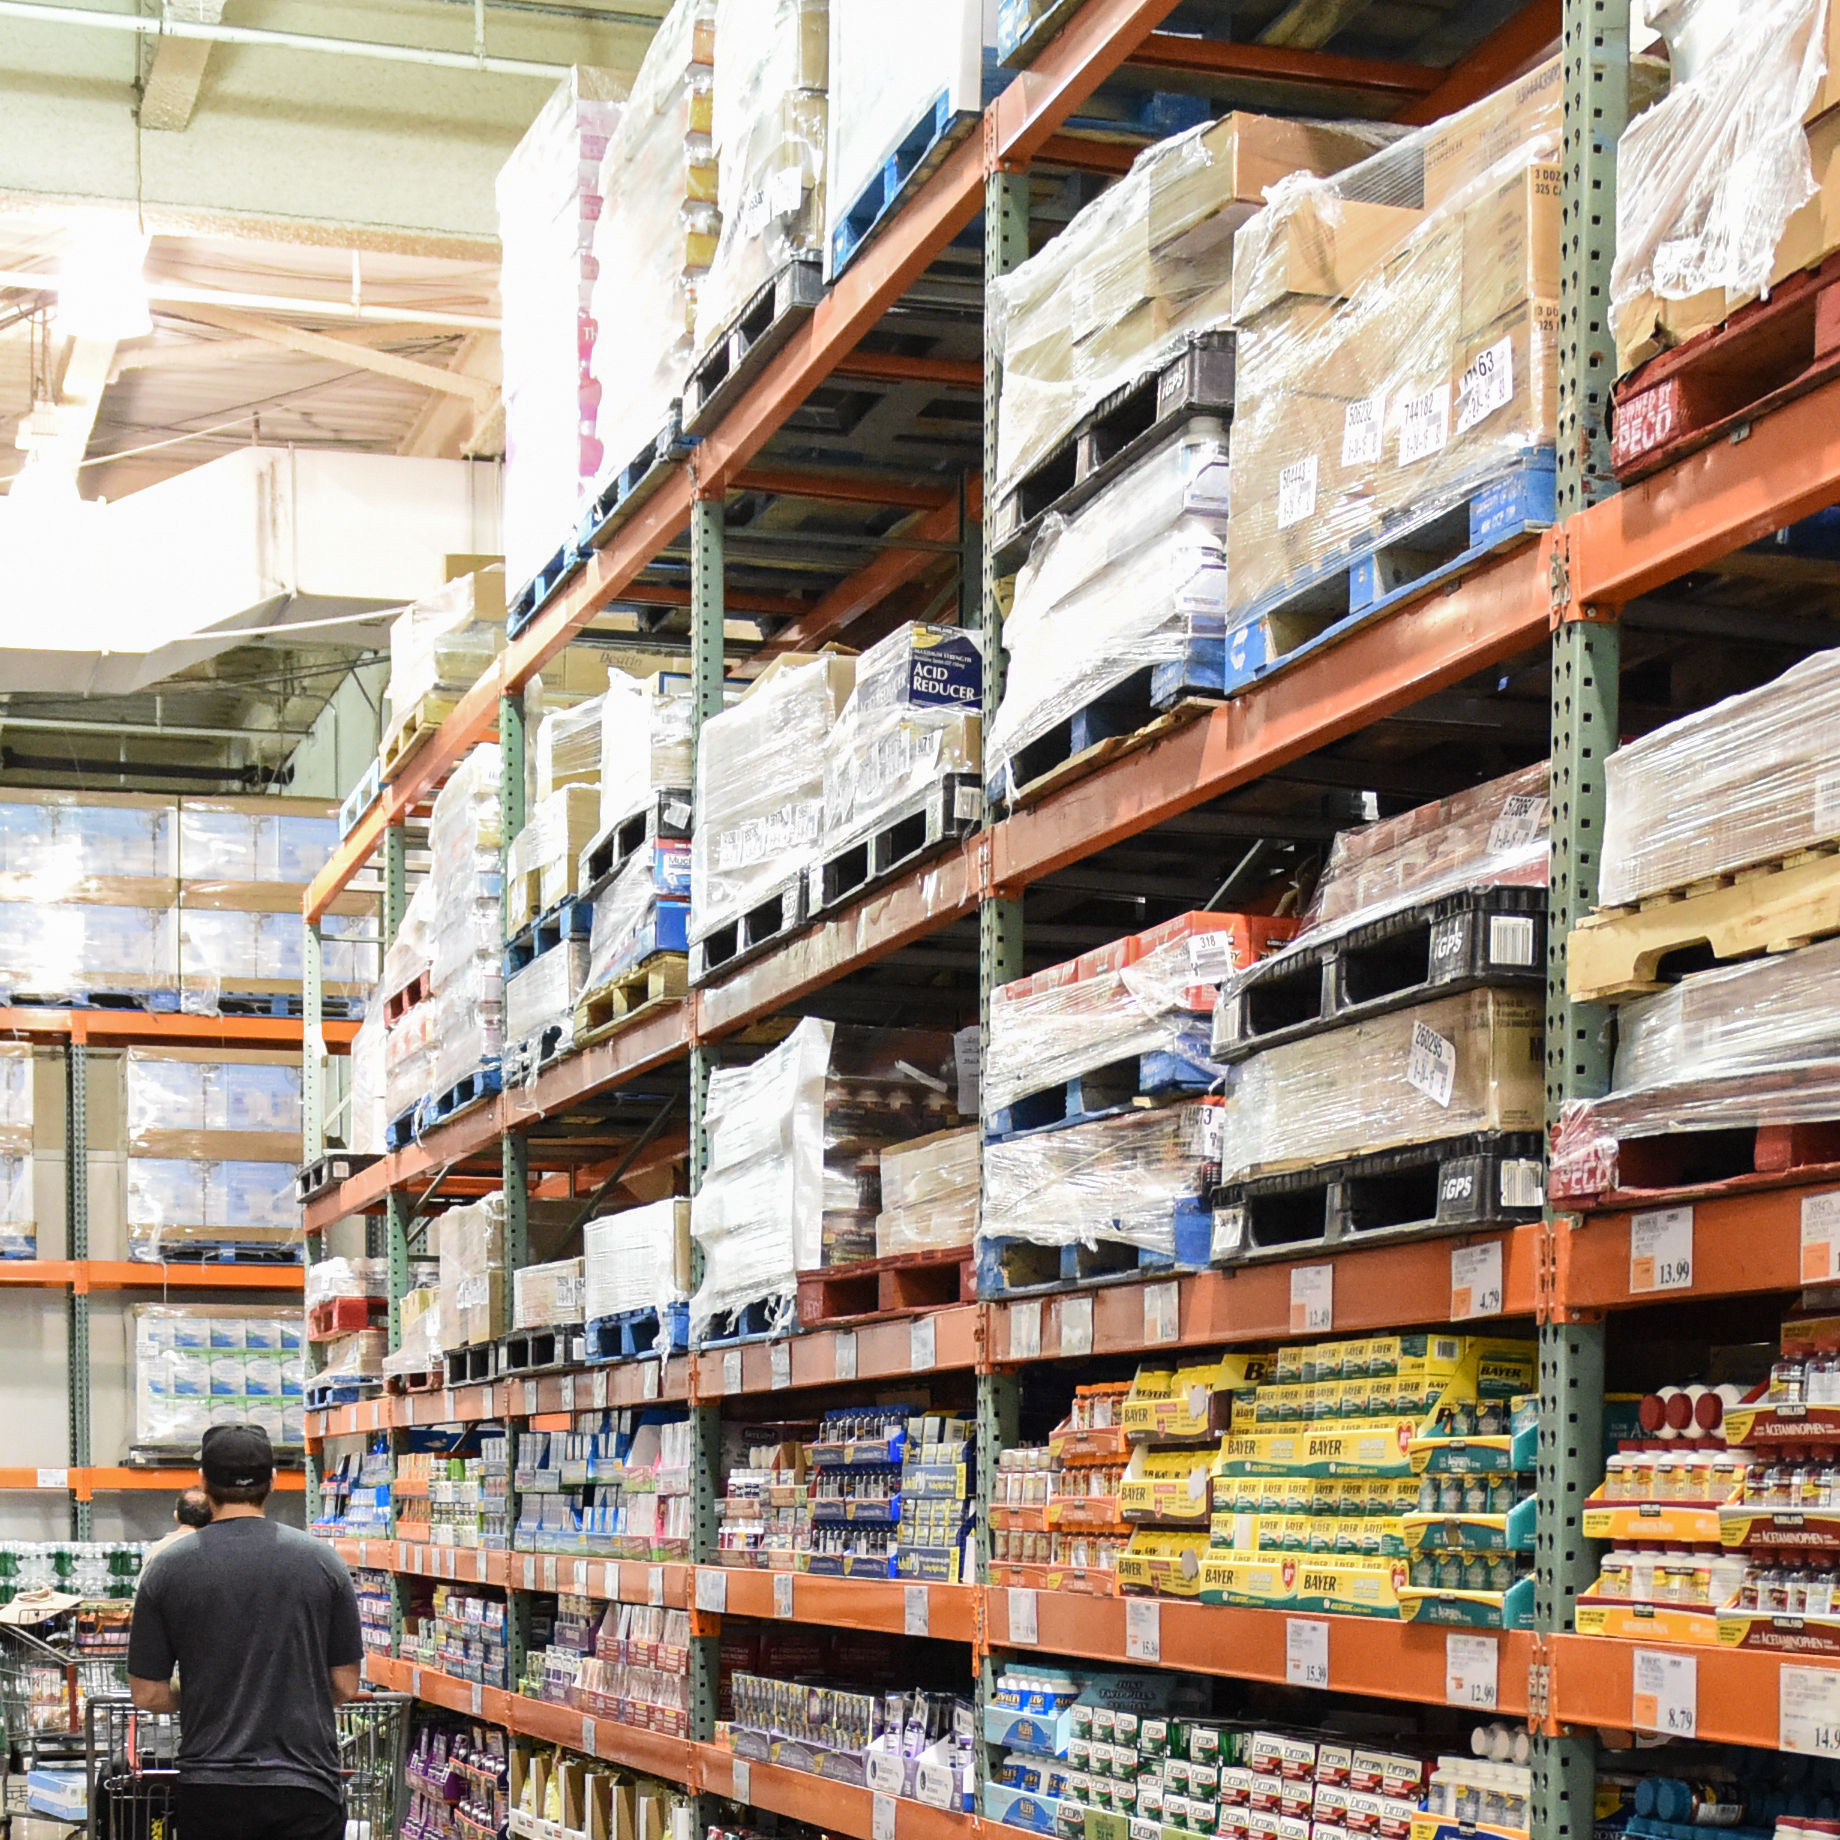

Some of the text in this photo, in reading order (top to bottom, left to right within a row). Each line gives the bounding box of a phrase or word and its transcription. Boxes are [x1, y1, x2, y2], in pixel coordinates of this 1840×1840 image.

[913, 662, 948, 680] ACID
[913, 676, 975, 700] REDUCER
[1434, 929, 1463, 961] iGPS
[1415, 1022, 1443, 1059] 260295
[1442, 1175, 1472, 1200] iGPS
[1660, 1261, 1689, 1284] 13.99
[1480, 1367, 1522, 1378] BAYER
[1227, 1439, 1257, 1457] BAYER
[1309, 1439, 1342, 1457] BAYER
[1204, 1568, 1234, 1585] BAYER
[1304, 1574, 1337, 1592] BAYER
[1470, 1684, 1495, 1704] 12.99
[1668, 1708, 1693, 1730] 8.79
